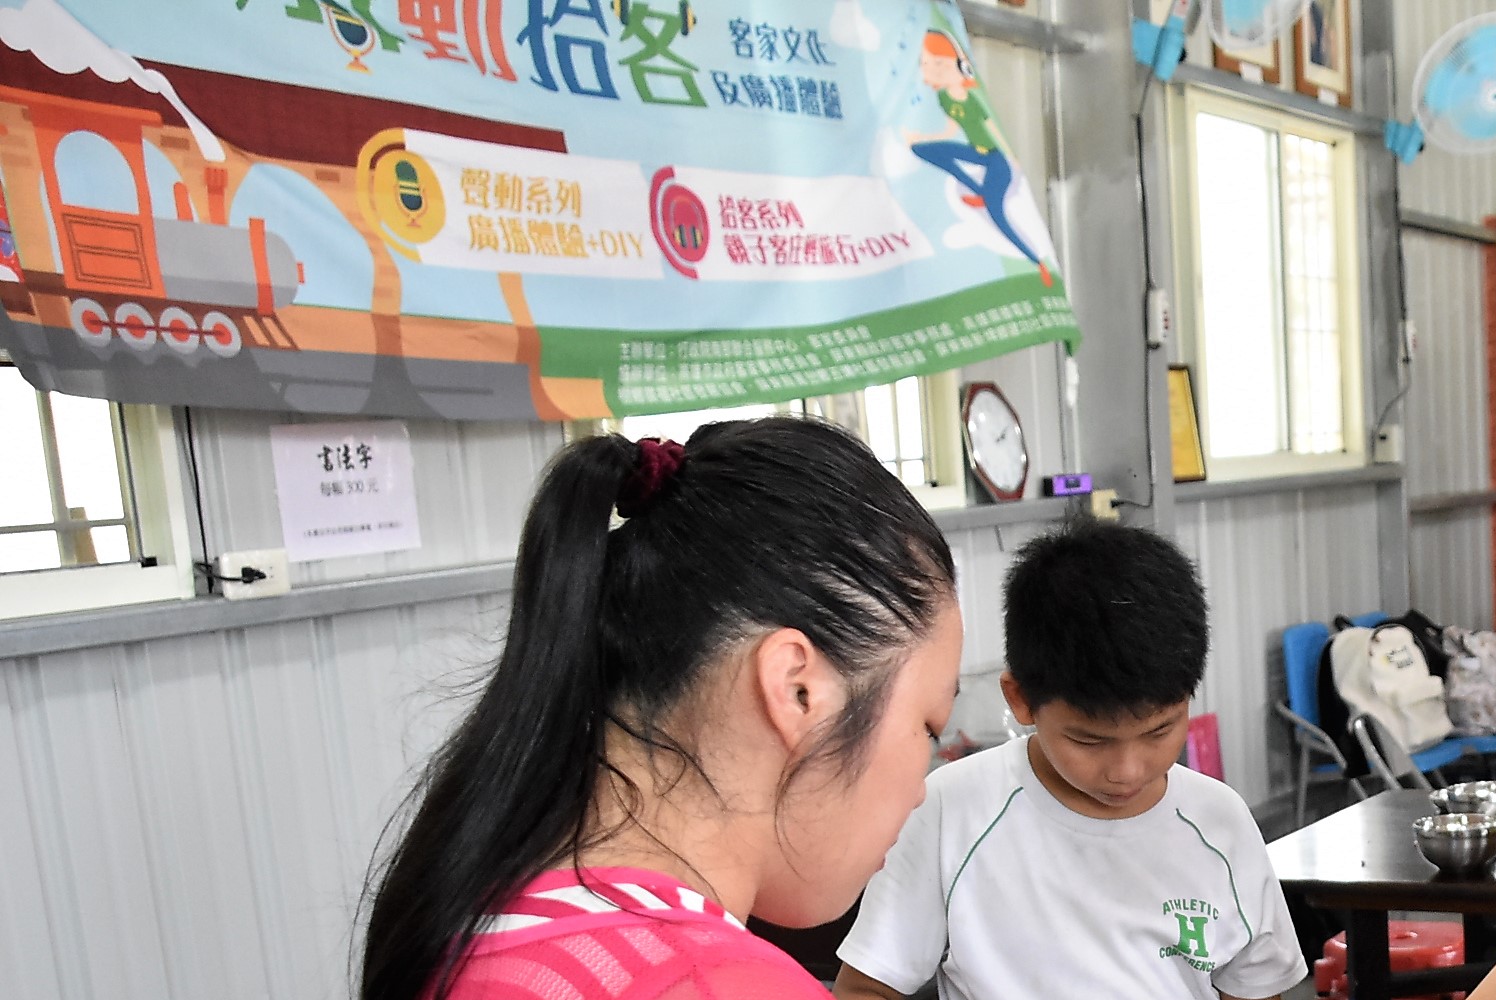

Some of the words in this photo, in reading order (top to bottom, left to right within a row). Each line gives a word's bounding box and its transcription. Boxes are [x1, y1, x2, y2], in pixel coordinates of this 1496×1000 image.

[728, 16, 837, 65] 客家文化
[461, 167, 582, 219] 聲動系列
[718, 194, 805, 230] 拾客系列
[317, 443, 373, 472] 書法字
[1162, 898, 1219, 920] ATHLETIC
[1174, 912, 1209, 958] H
